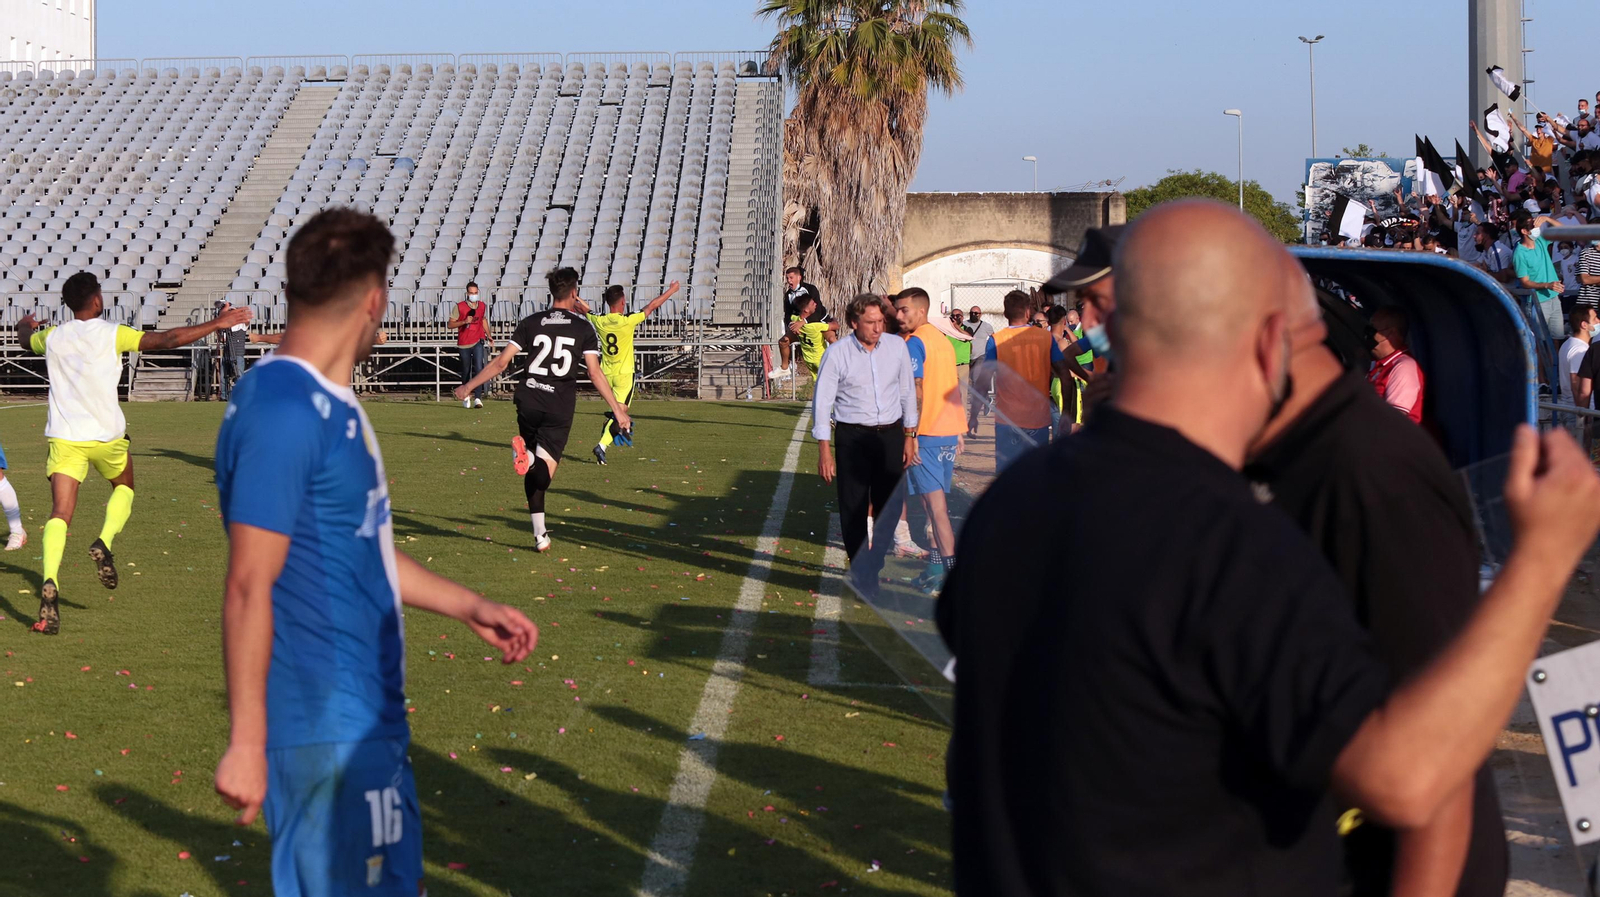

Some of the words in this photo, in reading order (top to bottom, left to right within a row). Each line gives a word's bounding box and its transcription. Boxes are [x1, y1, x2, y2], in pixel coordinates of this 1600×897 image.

[528, 334, 576, 377] 25
[606, 333, 619, 355] 8
[1551, 700, 1600, 788] P
[364, 786, 403, 848] 16
